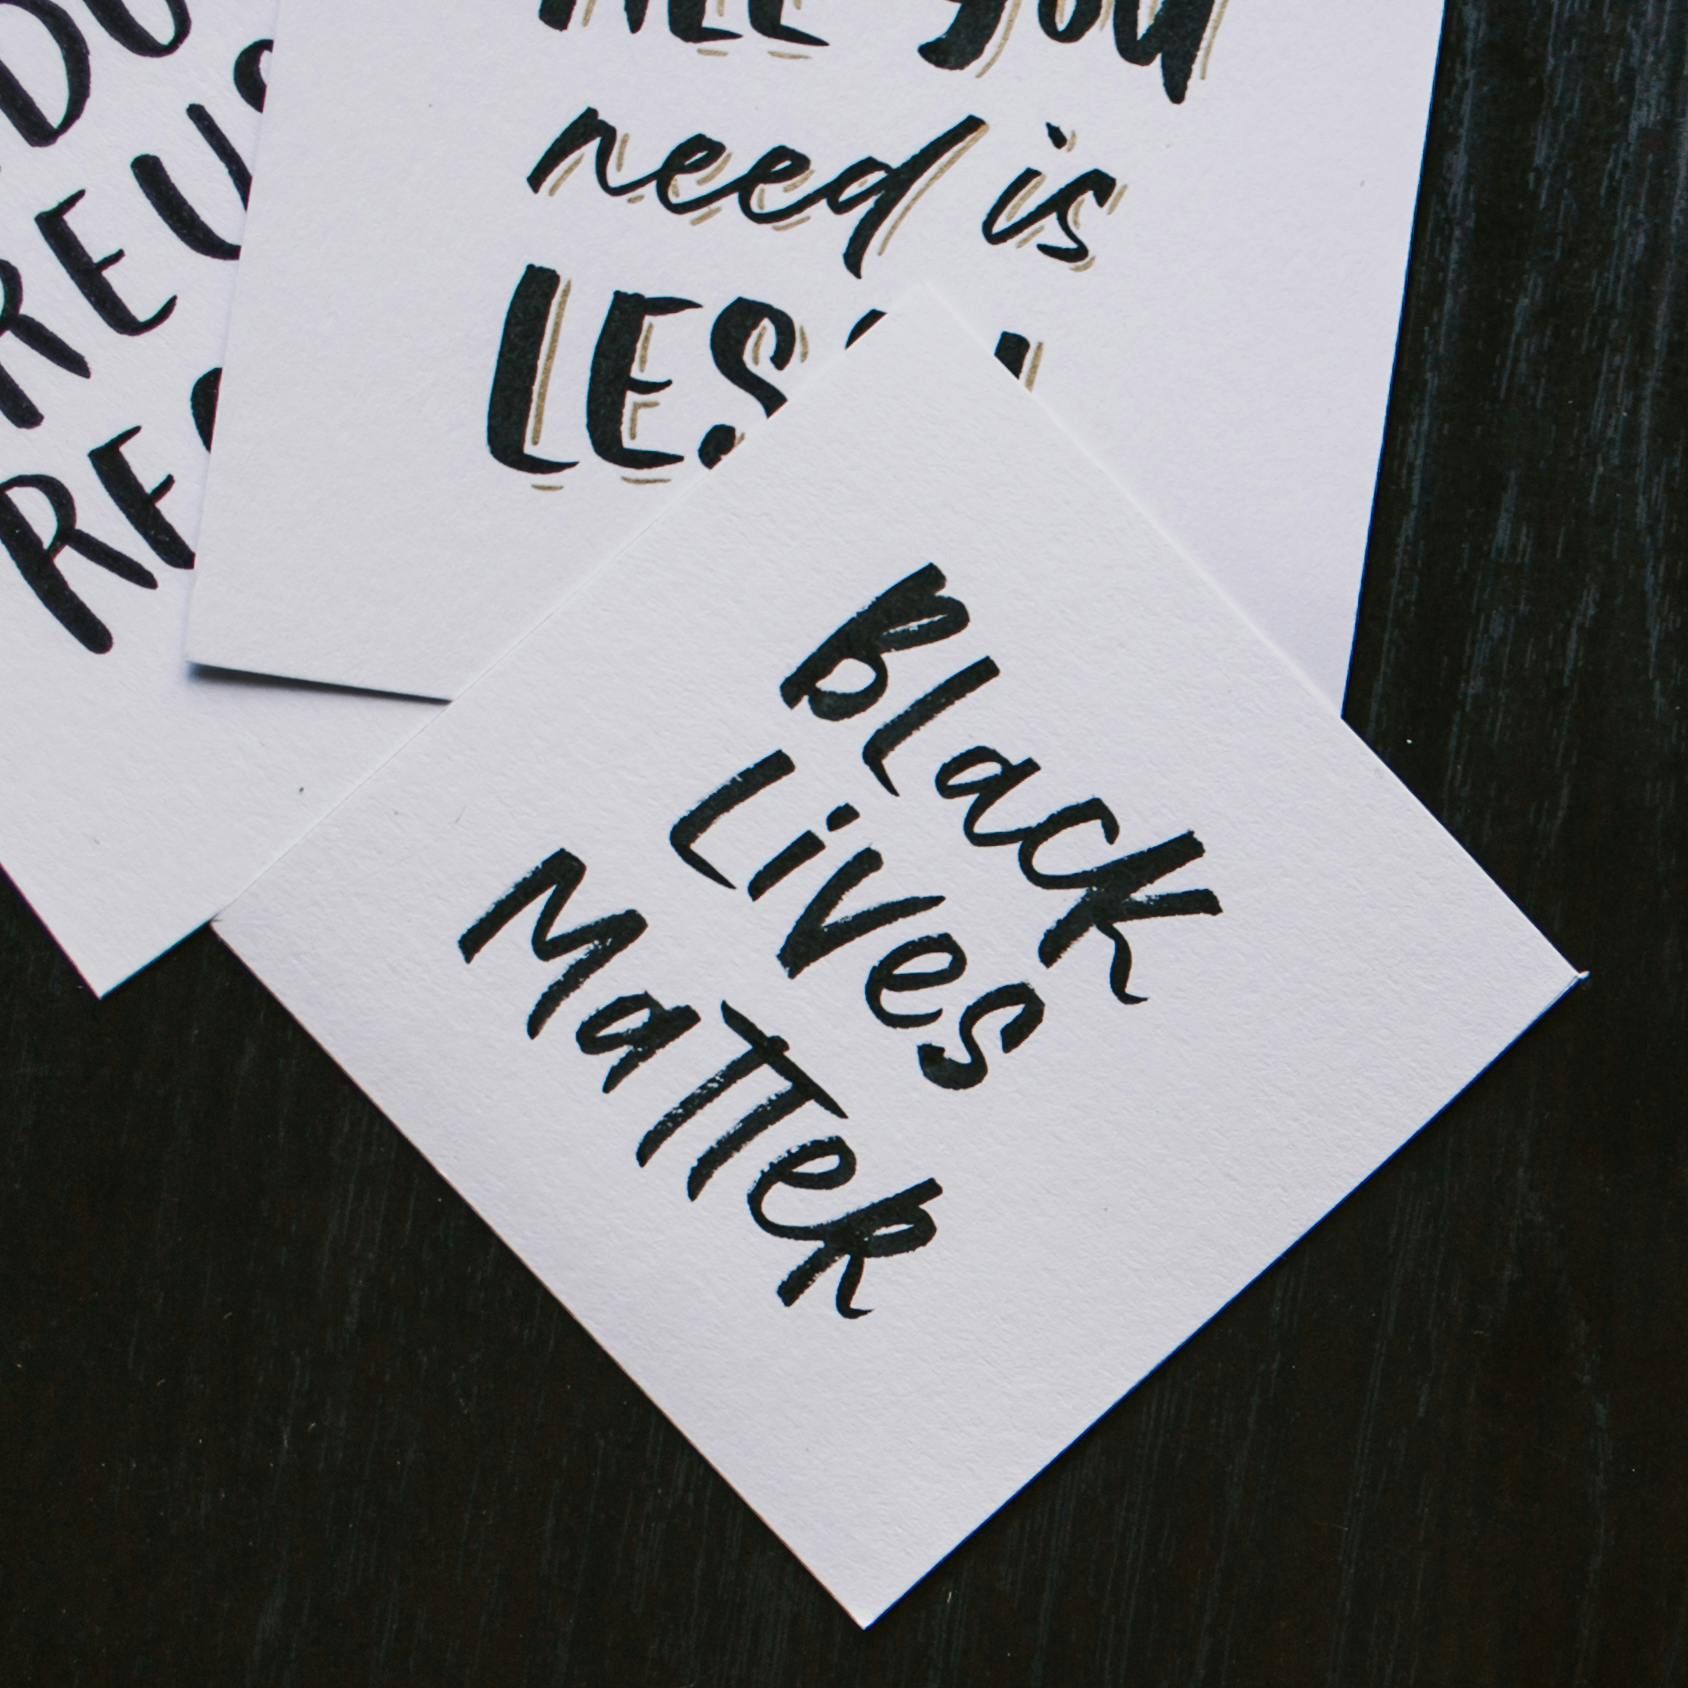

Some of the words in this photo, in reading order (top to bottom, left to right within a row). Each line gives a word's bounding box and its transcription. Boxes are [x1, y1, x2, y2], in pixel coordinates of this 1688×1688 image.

[526, 106, 989, 280] need
[981, 122, 1127, 271] is
[669, 749, 1046, 1091] Lives
